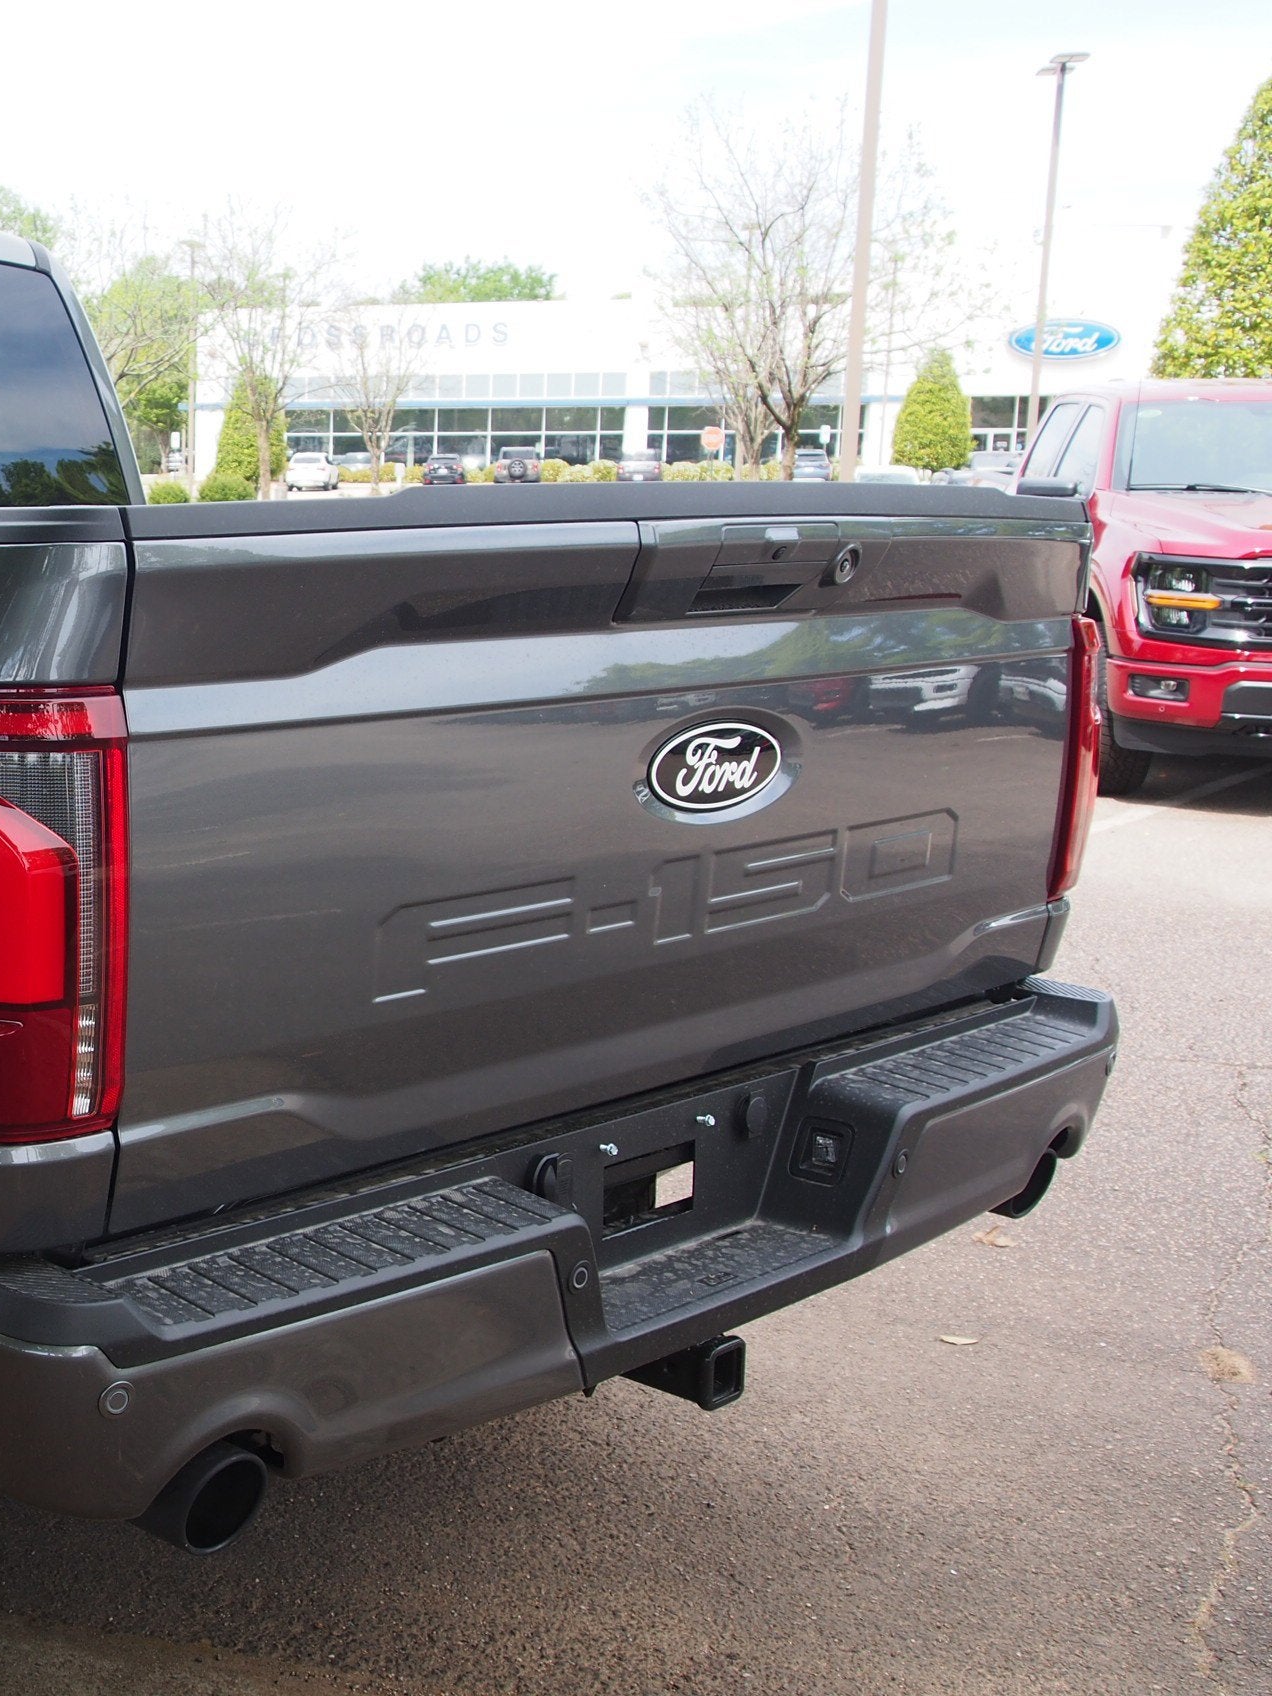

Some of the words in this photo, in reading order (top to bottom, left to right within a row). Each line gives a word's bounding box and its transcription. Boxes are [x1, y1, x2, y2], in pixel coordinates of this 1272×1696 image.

[1030, 326, 1101, 354] Ford
[675, 736, 761, 797] Ford
[373, 807, 959, 1003] F-150
